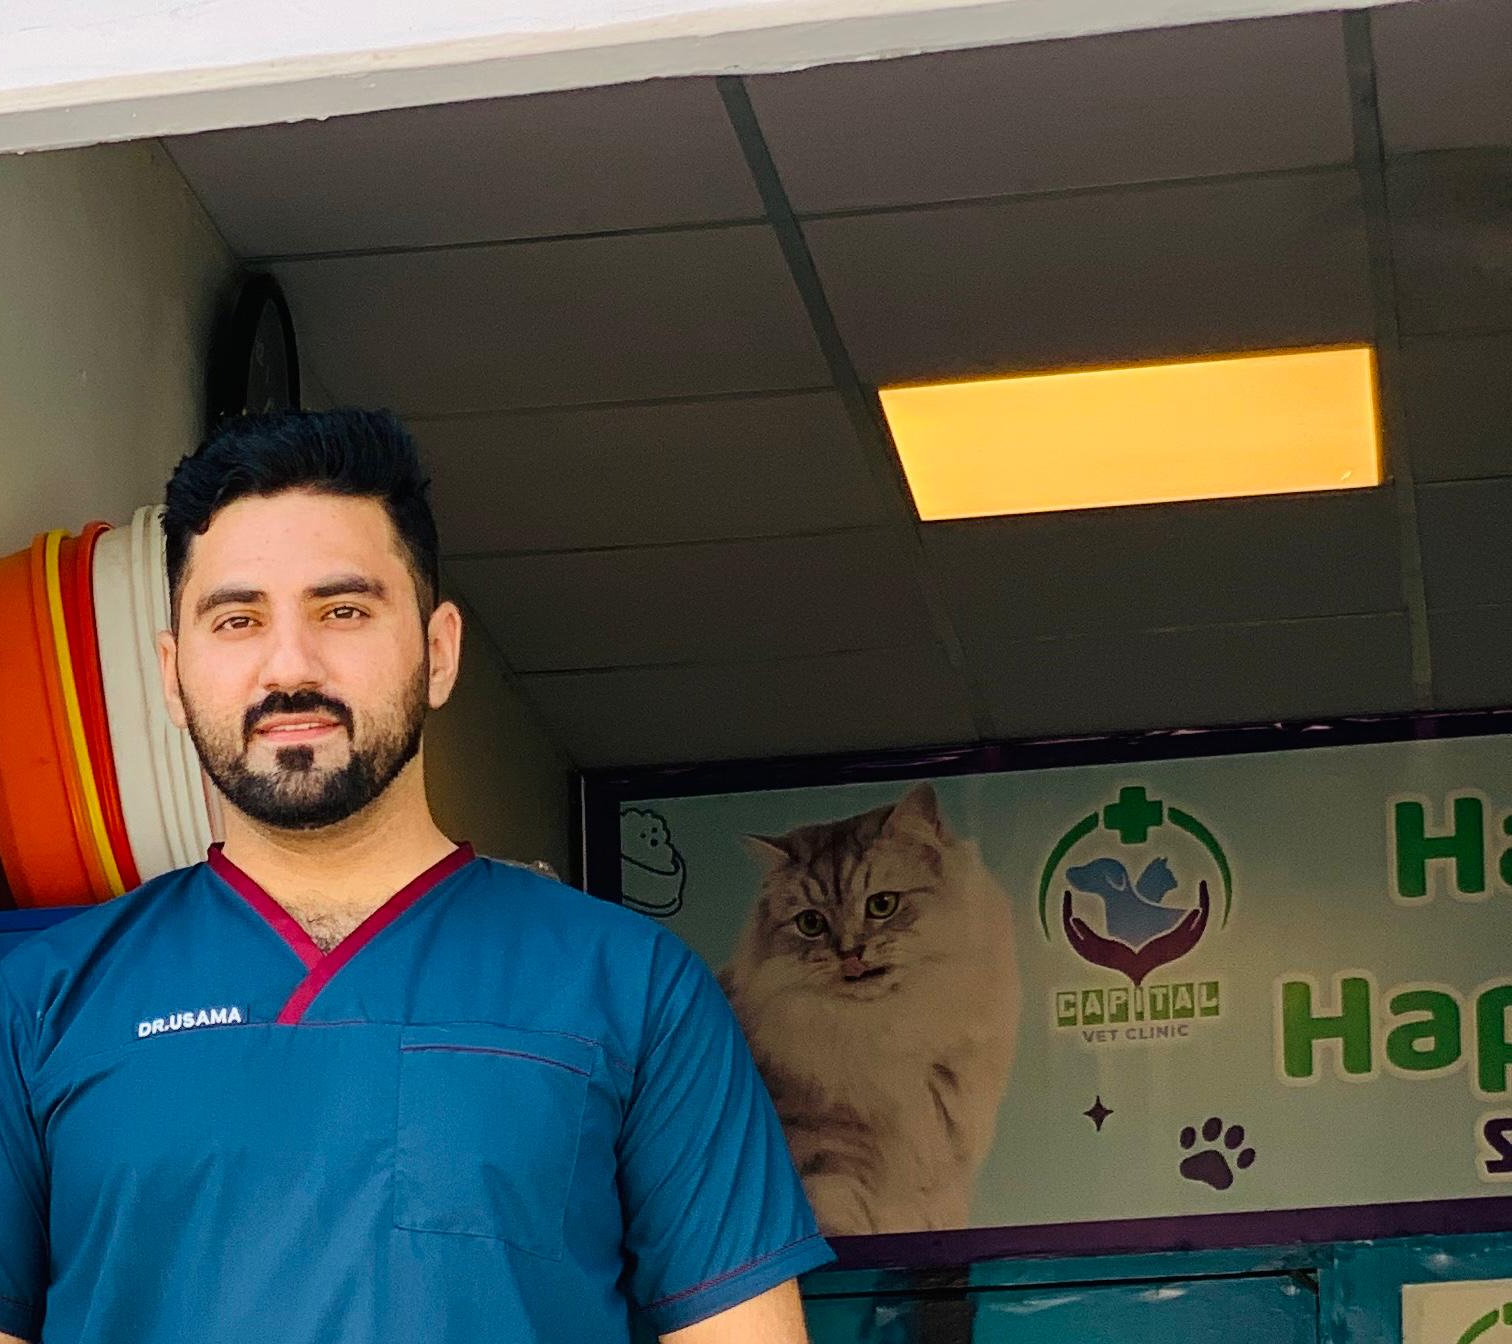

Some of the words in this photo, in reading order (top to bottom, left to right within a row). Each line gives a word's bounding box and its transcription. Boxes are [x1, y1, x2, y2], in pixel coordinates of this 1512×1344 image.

[1395, 797, 1512, 898] H
[138, 1007, 241, 1037] DR.USAMA
[1057, 981, 1219, 1027] CAPITAL
[1082, 1030, 1118, 1042] VET
[1125, 1024, 1189, 1040] CLINIC
